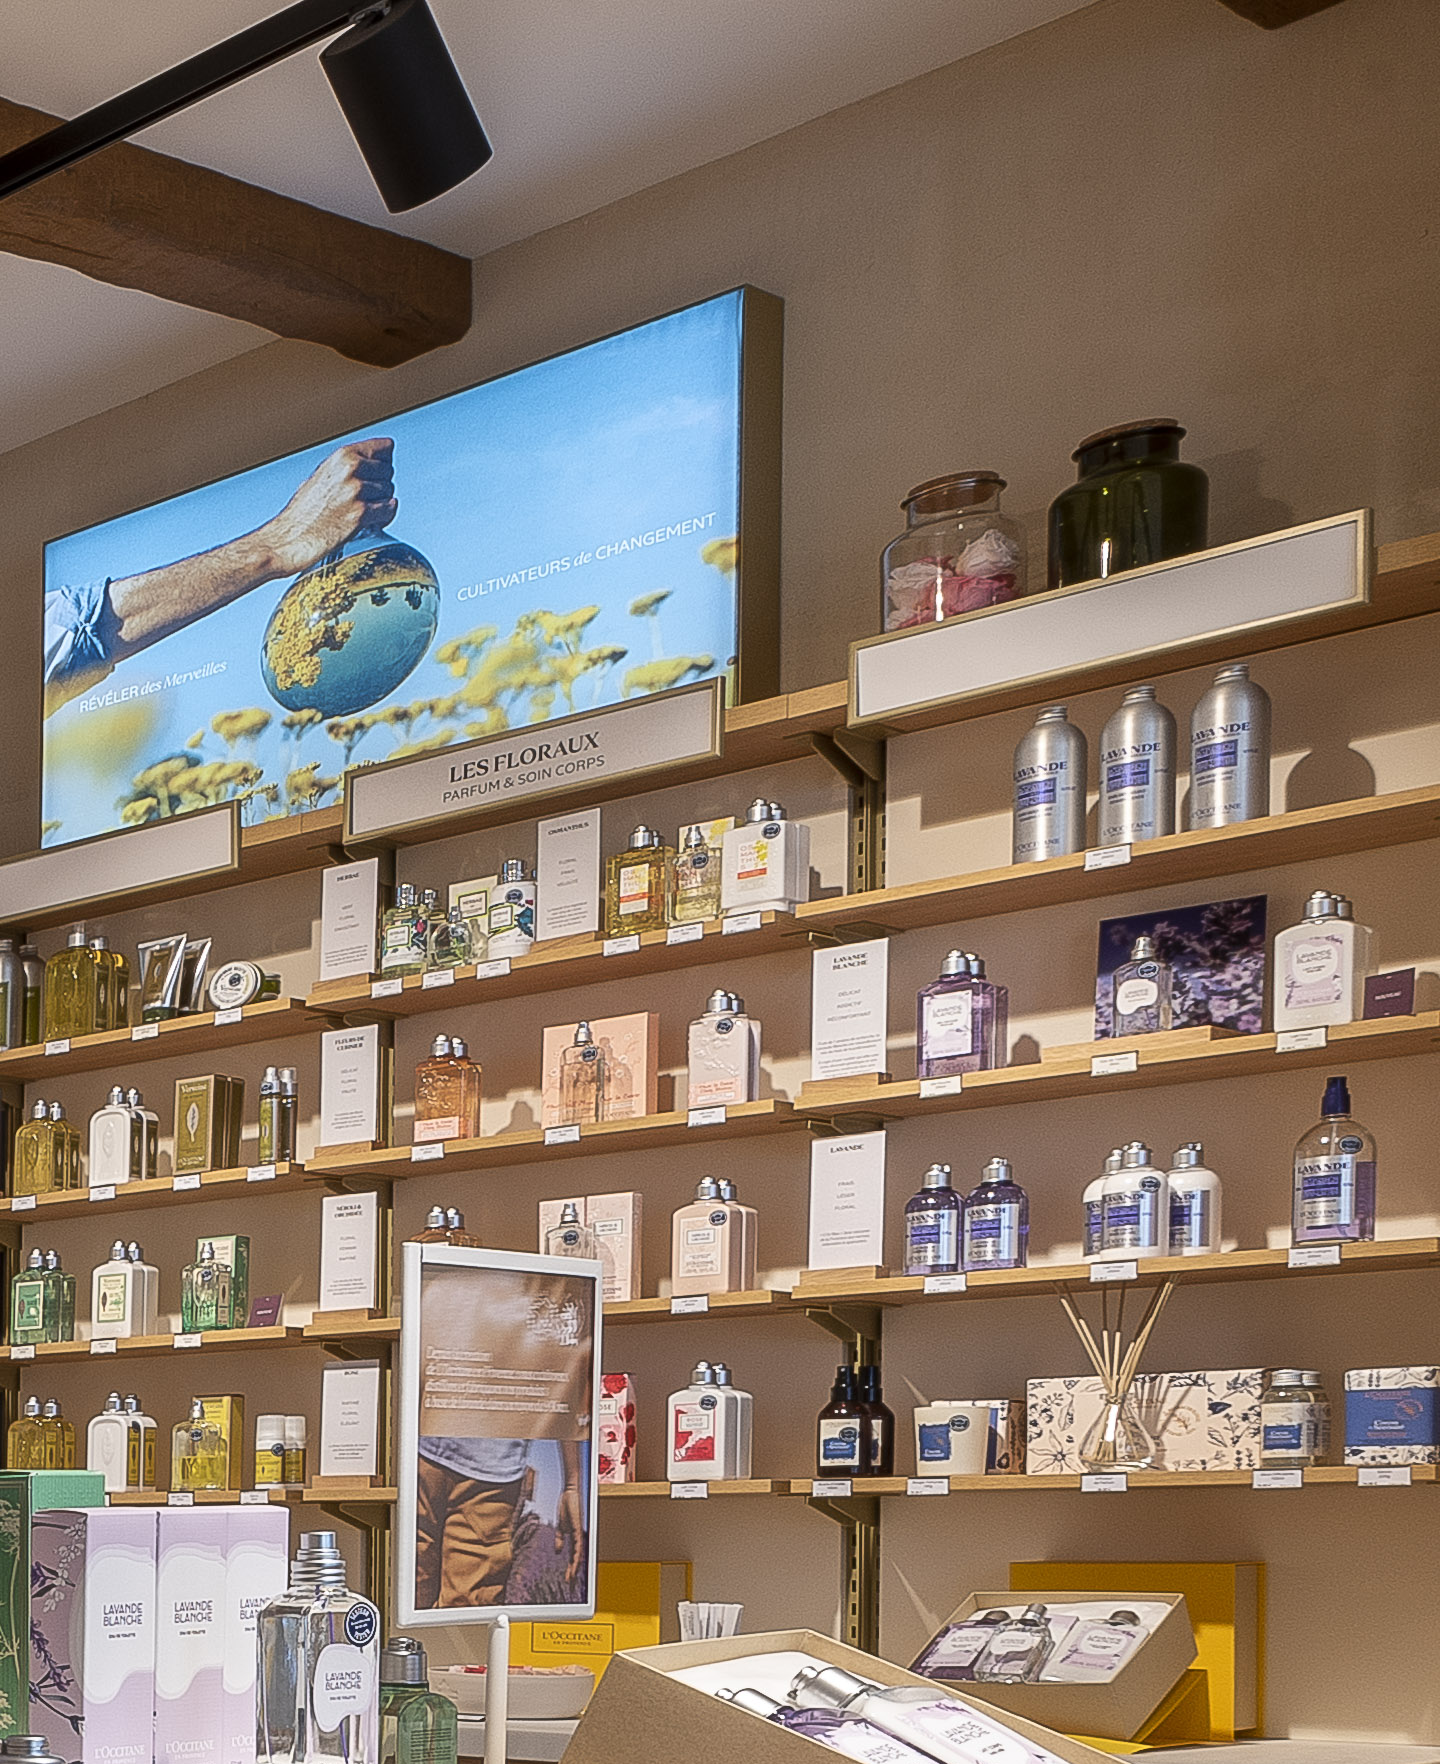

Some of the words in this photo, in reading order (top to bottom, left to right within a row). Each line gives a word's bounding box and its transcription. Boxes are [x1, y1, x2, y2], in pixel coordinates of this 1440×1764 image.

[456, 556, 572, 603] CULTIVATEURS
[573, 549, 592, 567] de
[594, 511, 717, 560] CHANGEMENT
[78, 684, 139, 714] RÉVÉLER
[140, 678, 162, 695] des
[163, 660, 228, 690] Merveilles
[449, 757, 490, 783] LES
[492, 730, 601, 775] FLORAUX
[1100, 742, 1161, 764] LAVANDE
[442, 778, 501, 804] PARFUM
[502, 774, 516, 790] &
[517, 765, 553, 788] SOIN
[555, 753, 606, 779] CORPS
[1297, 1160, 1351, 1174] LAVANDE
[103, 1602, 143, 1616] LAVANDE
[174, 1600, 213, 1613] LAVANDE
[103, 1613, 143, 1627] BLANCHE
[174, 1611, 213, 1624] BLANCHE
[542, 1630, 604, 1642] L'OCCITANE
[325, 1671, 362, 1682] LAVANDE
[325, 1680, 362, 1691] BLANCHE
[94, 1744, 146, 1760] L'OCCITANE
[165, 1739, 215, 1754] L'OCCITANE
